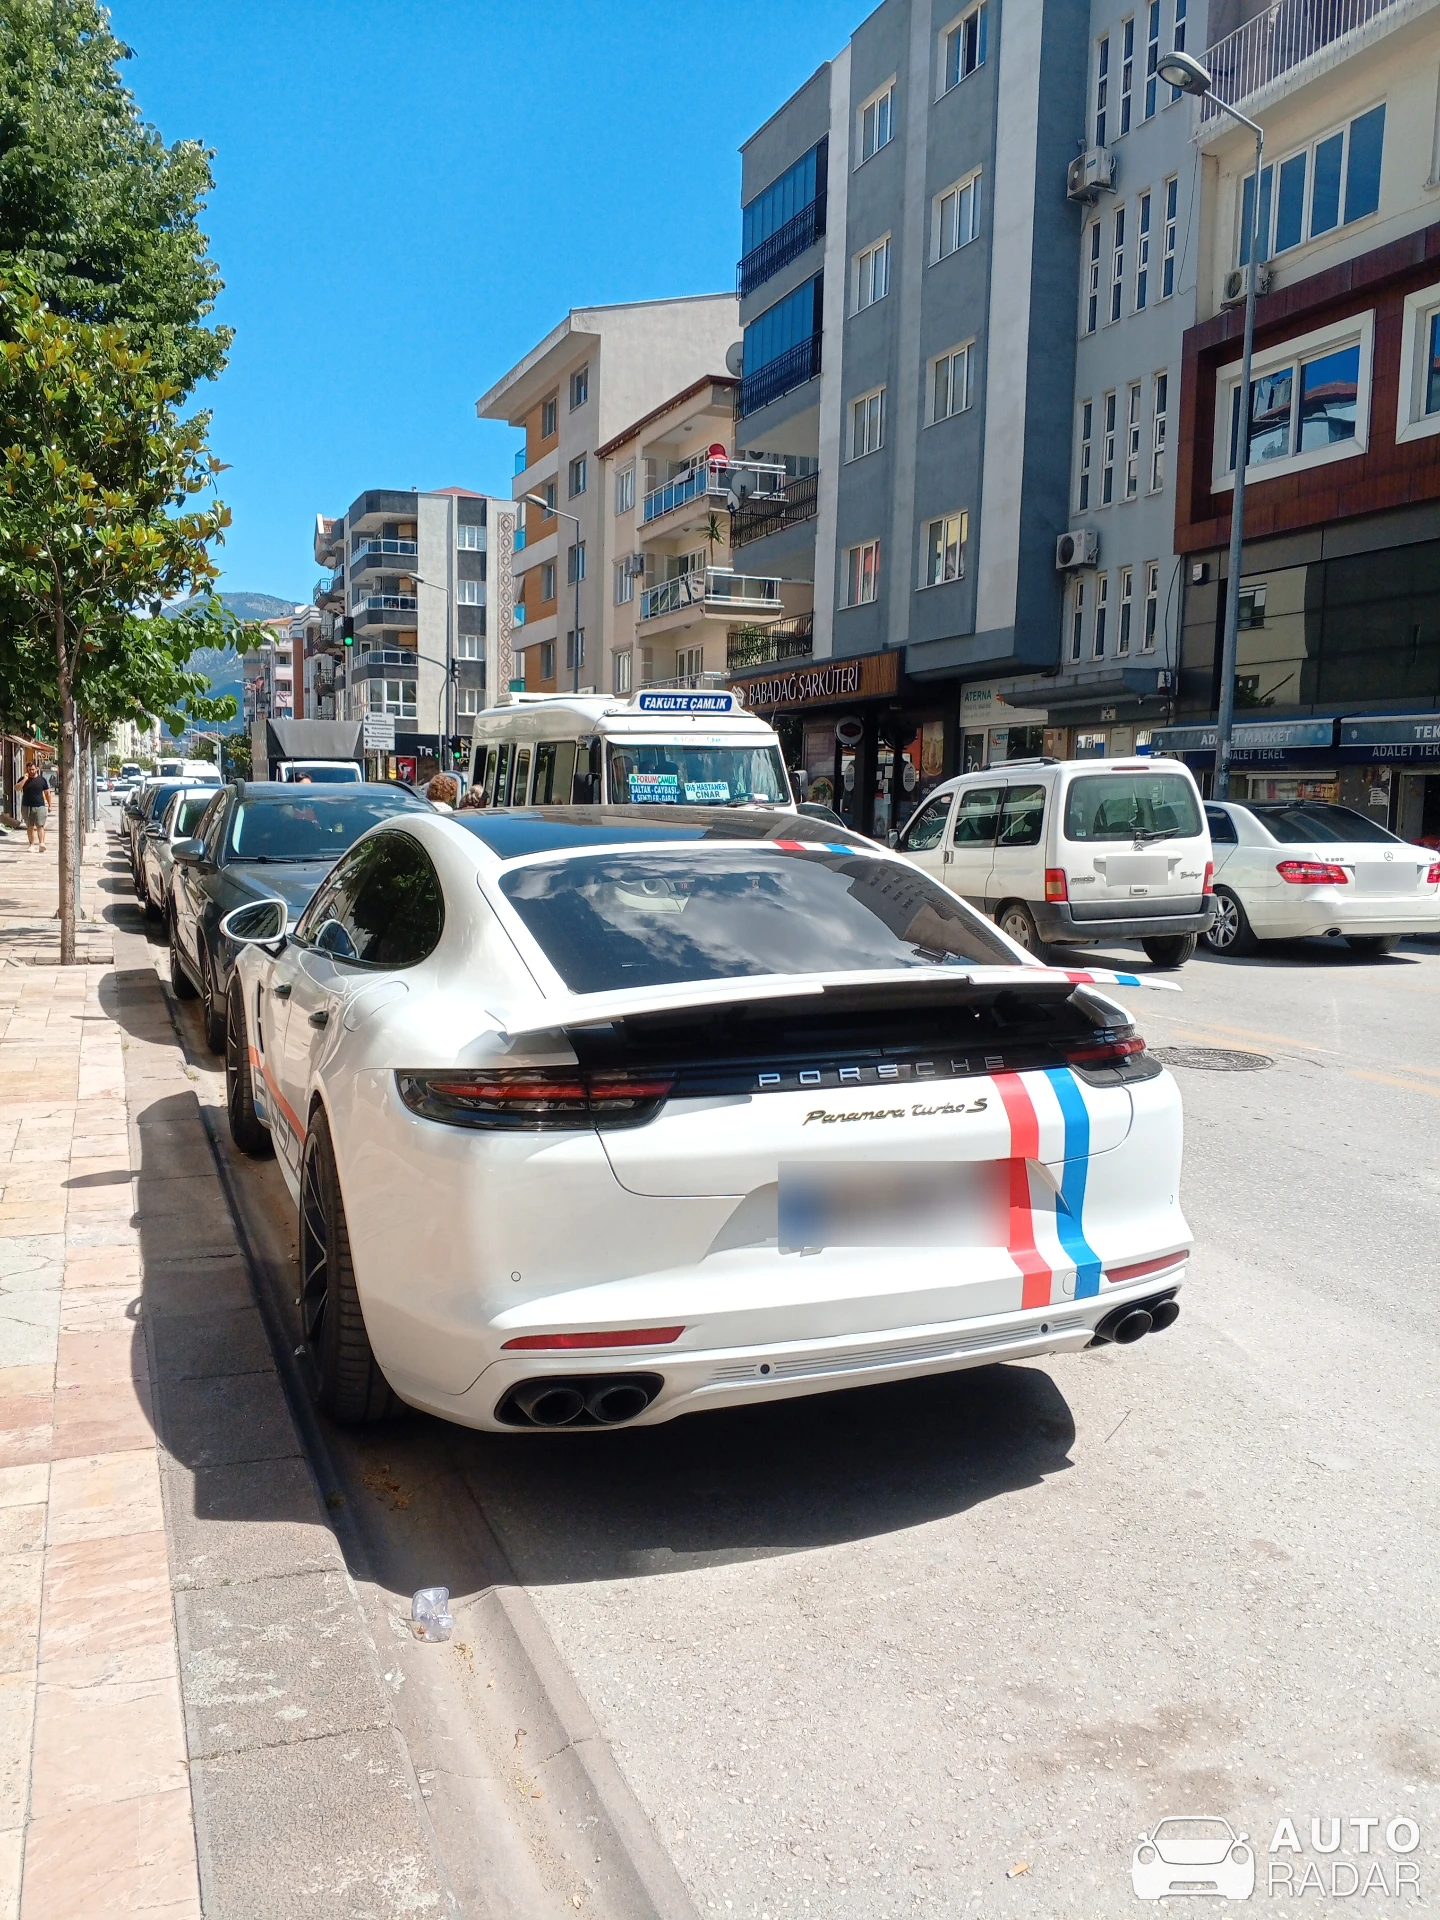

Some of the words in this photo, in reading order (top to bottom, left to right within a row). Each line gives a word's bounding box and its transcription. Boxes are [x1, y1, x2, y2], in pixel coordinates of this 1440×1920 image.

[748, 672, 797, 706] BABADAĞ
[798, 661, 859, 702] ŞARKÜTERİ
[964, 689, 992, 702] ATERNA
[643, 697, 688, 709] FAKÜLTE
[689, 697, 728, 710] ÇAMLIK
[1200, 730, 1241, 746] ADET
[1244, 730, 1293, 743] MARKET
[1258, 749, 1286, 760] TEKEL
[1371, 745, 1415, 757] ADALET
[758, 1055, 1005, 1087] PORSCHE
[802, 1109, 906, 1126] Panamera
[965, 1097, 988, 1114] S
